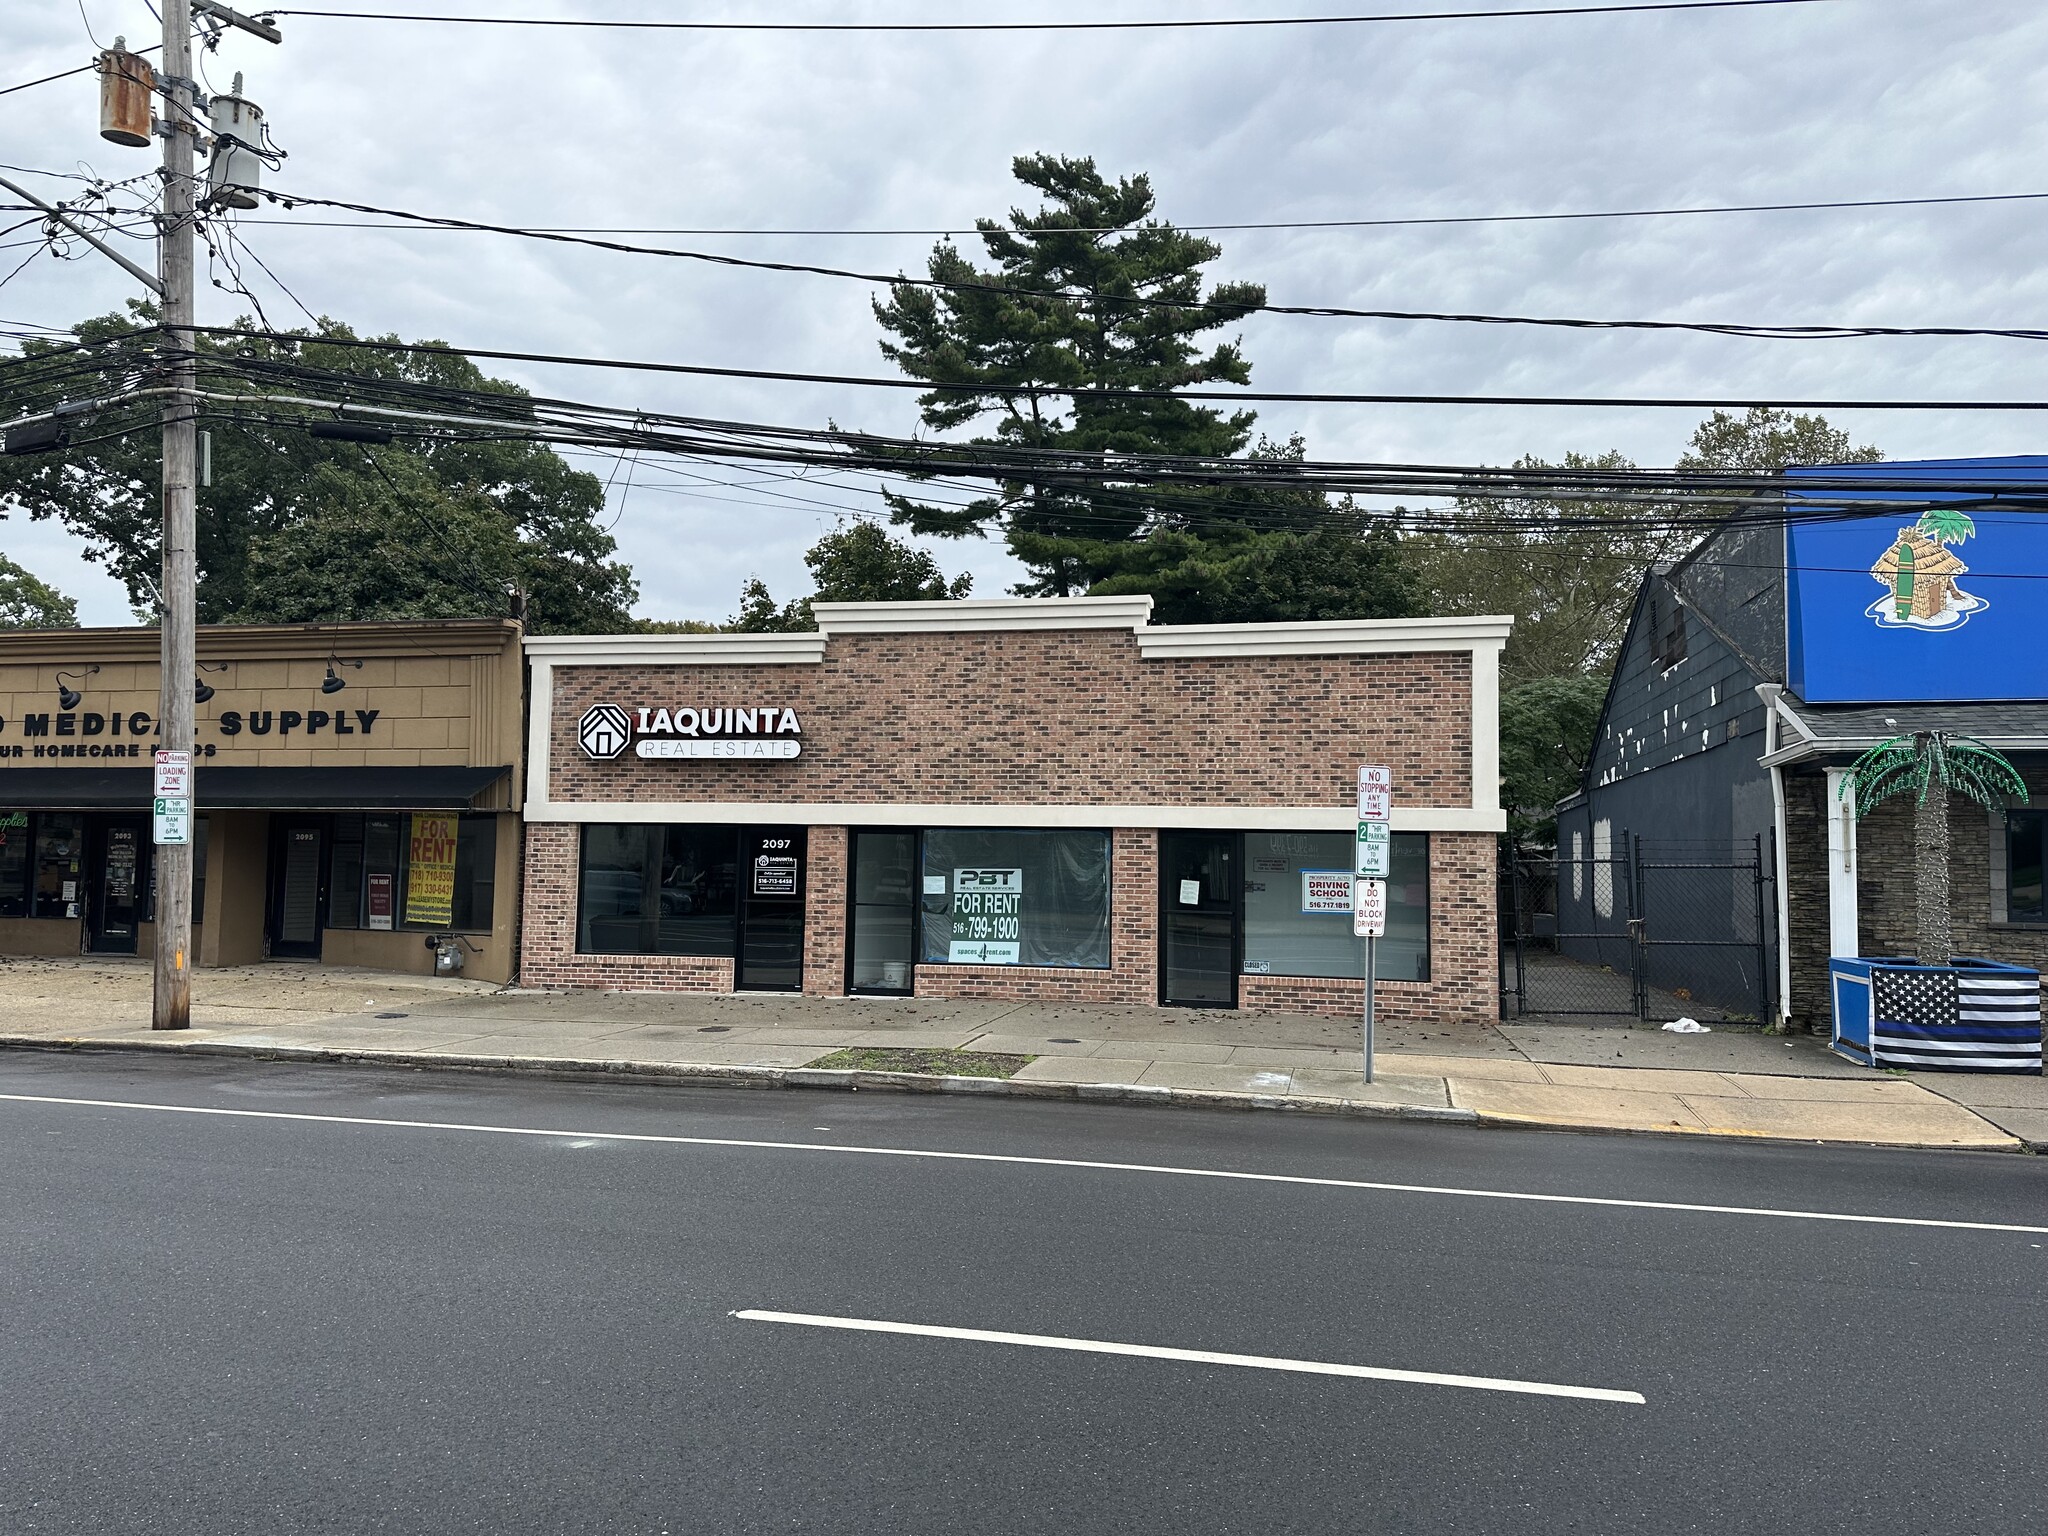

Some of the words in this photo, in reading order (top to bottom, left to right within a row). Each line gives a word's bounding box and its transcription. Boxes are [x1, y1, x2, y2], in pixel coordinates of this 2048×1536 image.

[24, 711, 199, 736] MEDIC
[219, 709, 380, 735] SUPPLY
[636, 707, 802, 737] IAQUINTA
[34, 743, 140, 757] HOMECARE
[644, 741, 698, 756] REAL
[712, 741, 792, 756] ESTATE
[157, 753, 168, 764] NO
[169, 753, 188, 762] PARKING
[159, 767, 187, 776] LOADING
[1368, 771, 1381, 782] NO
[164, 776, 181, 785] ZONE
[1360, 782, 1389, 794] STOPPING
[1367, 794, 1381, 802] ANY
[157, 801, 165, 813] 2
[1367, 802, 1382, 810] TIME
[420, 820, 449, 839] FOR
[1360, 825, 1367, 839] 2
[114, 832, 132, 840] 2093
[295, 833, 314, 841] 2095
[1368, 832, 1388, 840] PARKING
[762, 839, 791, 849] 2097
[1366, 843, 1380, 851] 8AM
[410, 837, 457, 864] RENT
[1366, 858, 1379, 866] 6PM
[960, 870, 1015, 886] PBT
[1308, 881, 1350, 890] DRIVING
[1309, 889, 1350, 898] SCHOOL
[1366, 888, 1379, 898] DO
[953, 893, 981, 914] FOR
[984, 893, 1021, 914] RENT
[1309, 901, 1351, 909] 516.717.1819
[1364, 899, 1380, 908] NOT
[1358, 909, 1383, 919] BLOCK
[1357, 920, 1383, 928] DRIVEWAY
